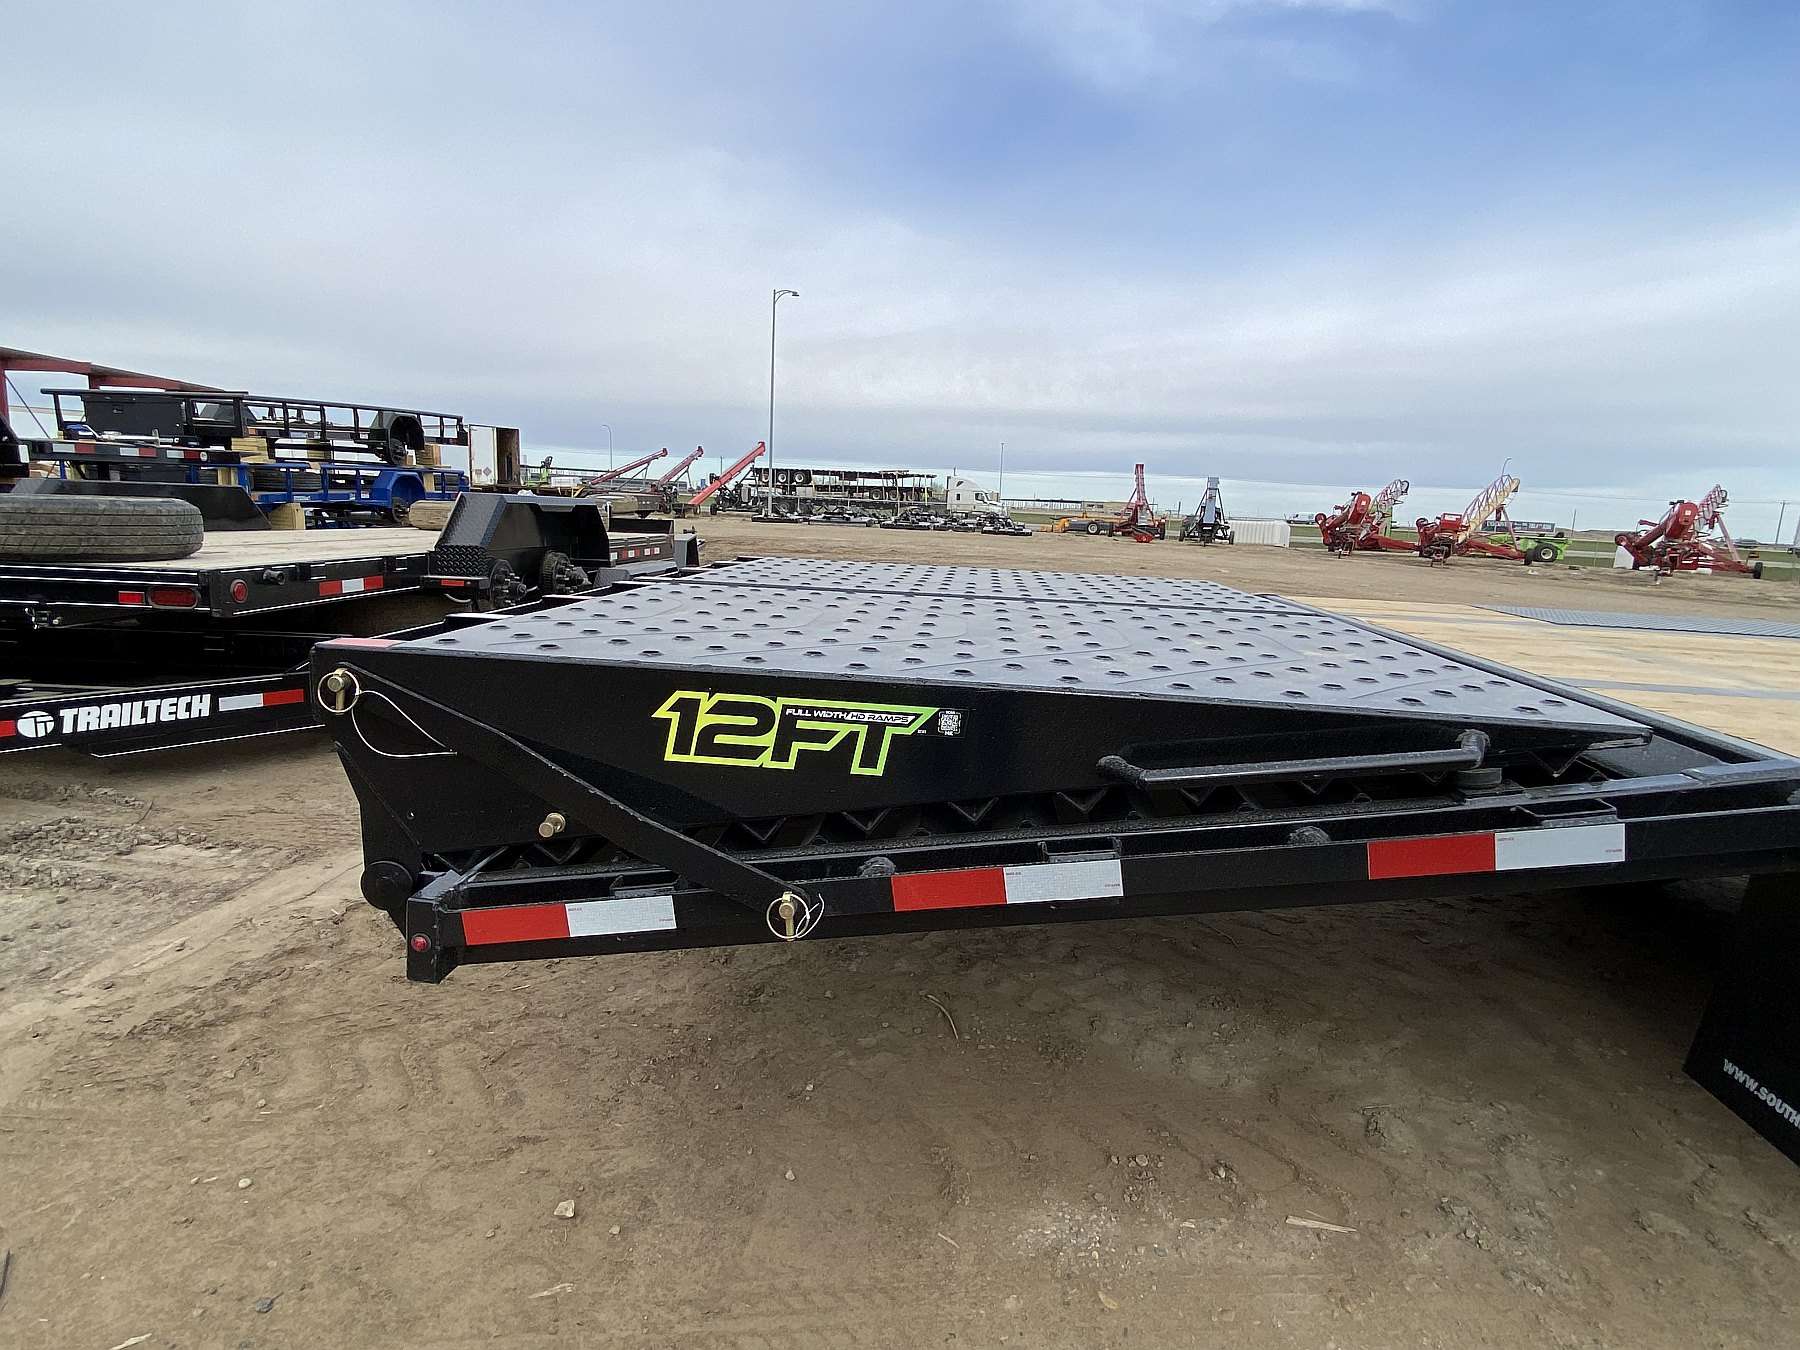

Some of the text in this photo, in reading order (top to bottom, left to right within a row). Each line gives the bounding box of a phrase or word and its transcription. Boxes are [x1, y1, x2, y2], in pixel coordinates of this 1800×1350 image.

[60, 694, 211, 734] TRAILTECH
[651, 690, 939, 775] 12FT
[786, 708, 811, 717] FULL
[867, 714, 909, 723] RAMPS
[1723, 1059, 1800, 1130] WWW.SOUTH
